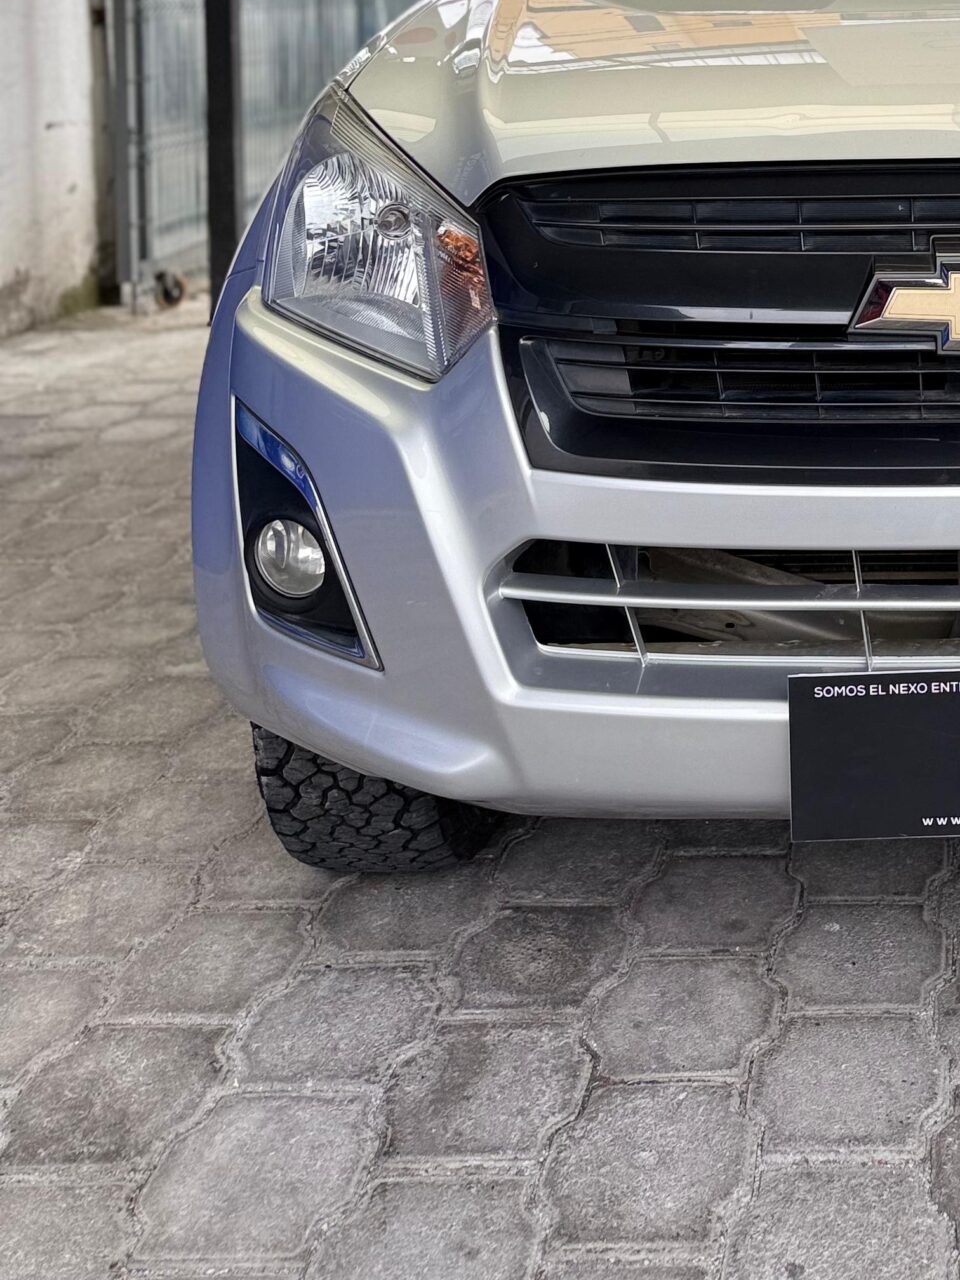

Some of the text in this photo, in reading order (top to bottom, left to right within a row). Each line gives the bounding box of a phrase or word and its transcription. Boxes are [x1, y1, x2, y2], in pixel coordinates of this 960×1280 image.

[813, 684, 867, 699] SOMOS
[869, 683, 887, 696] EL
[889, 682, 929, 695] NEXO
